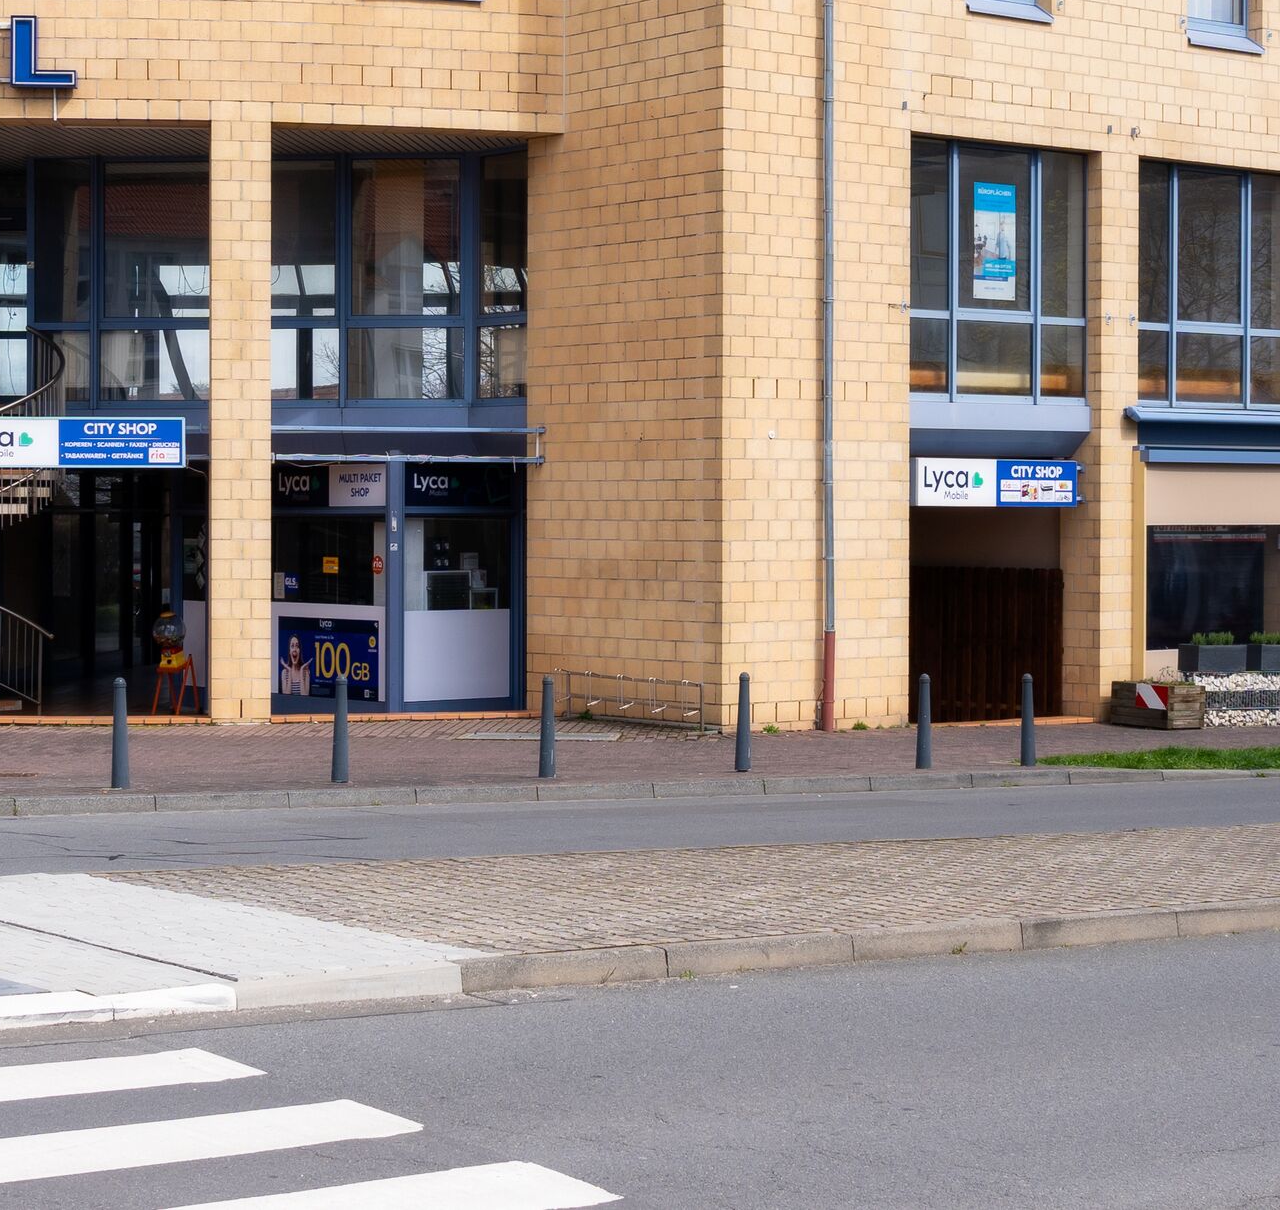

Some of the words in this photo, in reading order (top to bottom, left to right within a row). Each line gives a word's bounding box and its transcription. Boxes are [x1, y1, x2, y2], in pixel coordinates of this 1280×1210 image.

[83, 422, 116, 435] CITY
[117, 422, 158, 435] SHOP
[64, 452, 107, 460] TABAKWAREN
[111, 451, 144, 460] GETRÄNKE
[150, 449, 166, 460] ria
[1010, 465, 1034, 478] CITY
[1035, 465, 1063, 478] SHOP
[278, 472, 310, 494] Lyca
[338, 474, 359, 484] MULTI
[360, 472, 382, 483] PAKET
[413, 473, 448, 492] Lyca
[923, 465, 969, 492] Lyca
[350, 487, 370, 498] SHOP
[943, 491, 969, 500] Mobile
[284, 577, 296, 586] GLS
[314, 641, 351, 680] 100
[351, 662, 370, 681] GB
